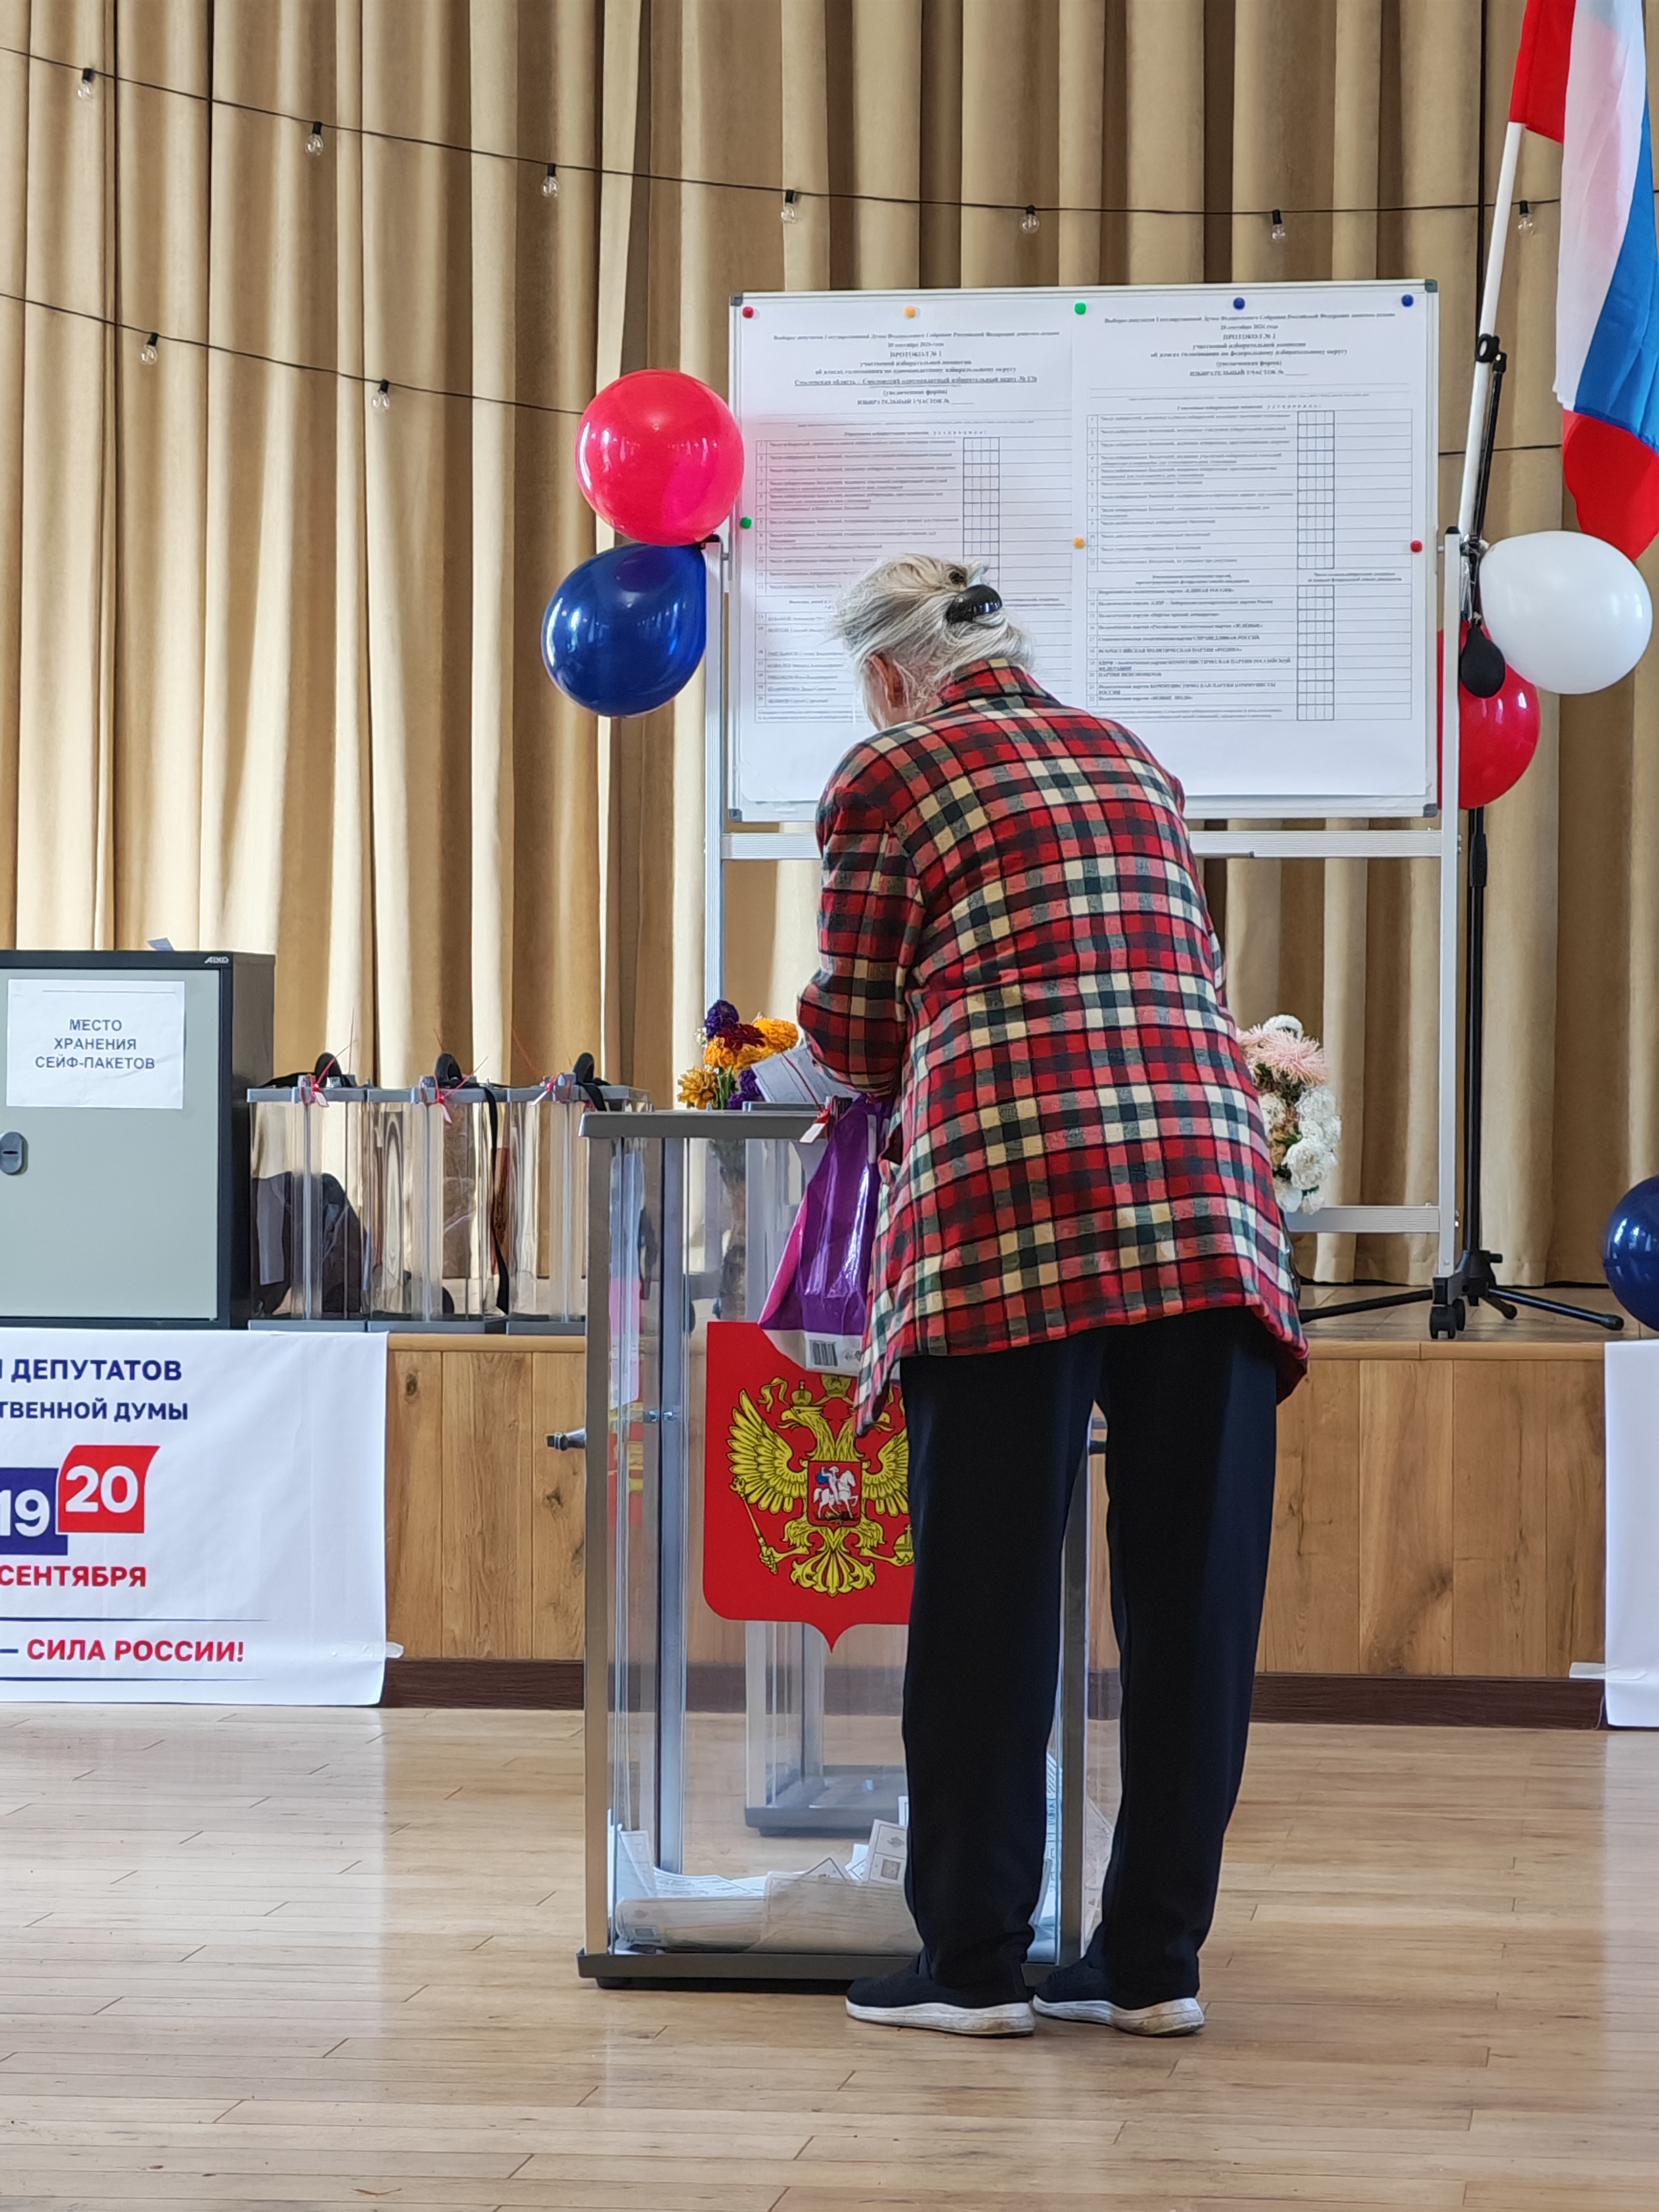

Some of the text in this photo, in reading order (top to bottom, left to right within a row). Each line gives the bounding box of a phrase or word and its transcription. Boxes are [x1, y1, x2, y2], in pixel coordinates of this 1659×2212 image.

[69, 1019, 122, 1031] МЕСТО
[54, 1038, 137, 1050] ХРАНЕНИЯ
[35, 1054, 155, 1070] СЕЙФ-ПАКЕТОВ
[11, 1359, 183, 1383] ДЕПУТАТОВ
[114, 1402, 188, 1422] ДУМЫ
[65, 1465, 139, 1513] 20
[0, 1489, 50, 1537] 19
[0, 1564, 147, 1587] СЕНТЯБРЯ
[27, 1638, 245, 1662] СИЛА РОССИИ!
